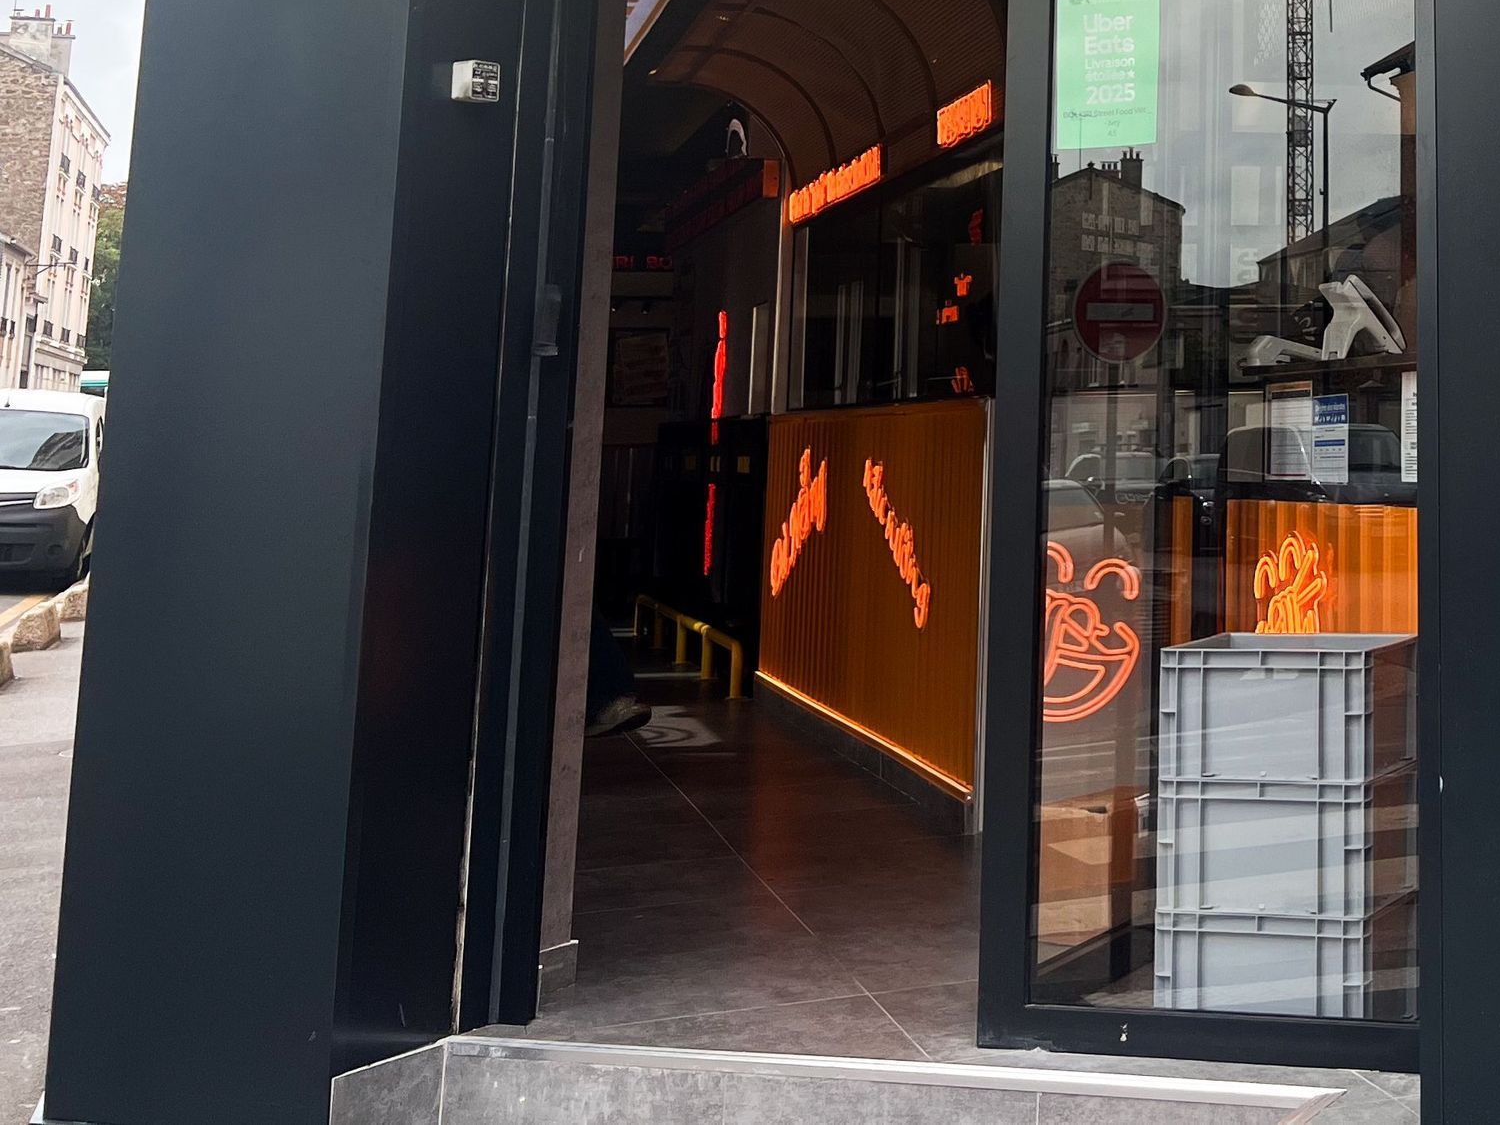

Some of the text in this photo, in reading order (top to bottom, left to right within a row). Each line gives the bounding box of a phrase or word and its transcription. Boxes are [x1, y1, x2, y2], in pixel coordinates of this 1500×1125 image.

[1083, 13, 1134, 33] Uber
[1084, 35, 1136, 55] Eats
[1086, 82, 1136, 105] 2025
